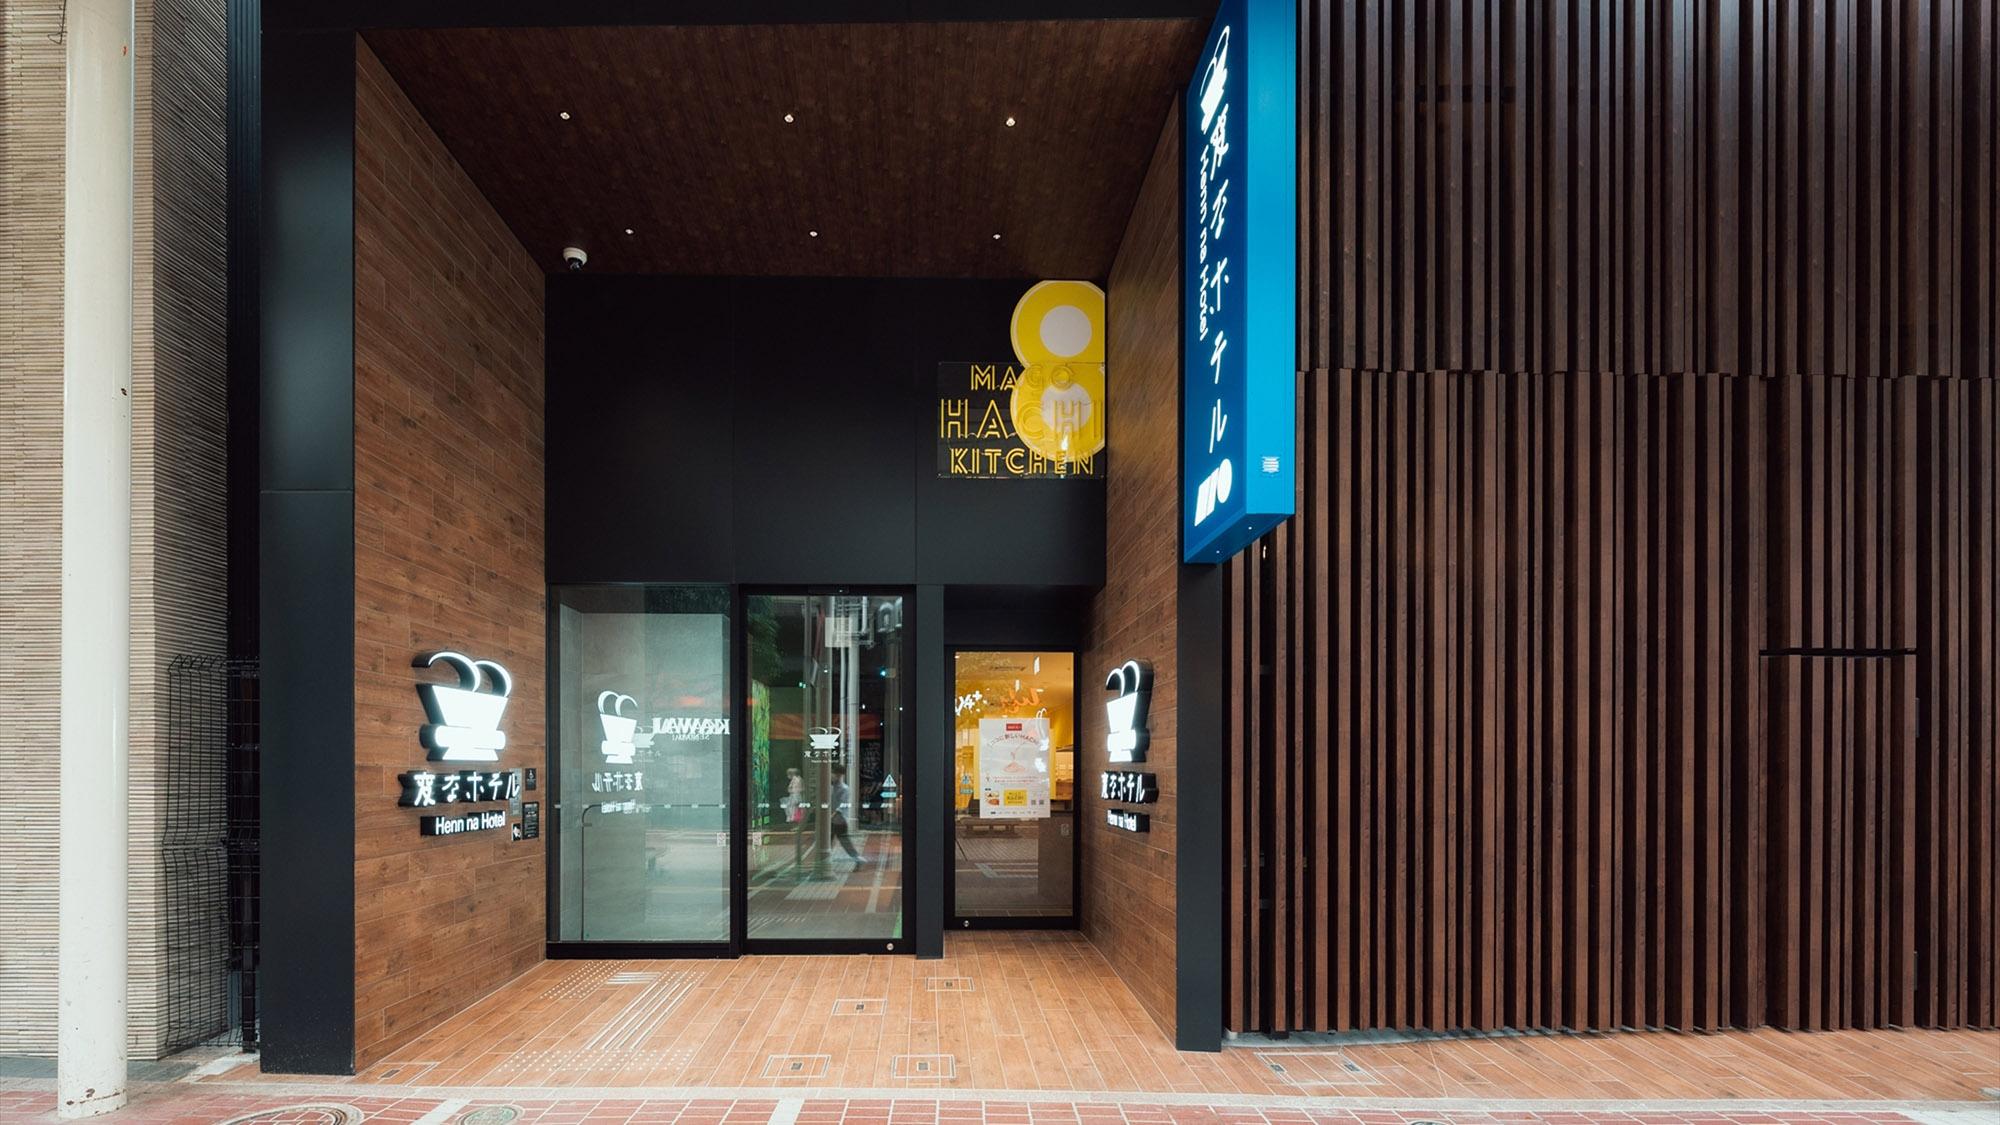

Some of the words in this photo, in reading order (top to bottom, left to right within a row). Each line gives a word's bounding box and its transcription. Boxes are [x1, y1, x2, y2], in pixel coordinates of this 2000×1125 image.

[1200, 144, 1209, 223] Henn
[1200, 226, 1208, 264] na
[1210, 103, 1229, 454] 変なホテル
[1200, 264, 1209, 341] Hotel
[940, 398, 1104, 439] HACHI
[950, 448, 1093, 475] KITCHEN
[413, 771, 521, 807] 変なホテル
[1101, 772, 1145, 803] 変なホテル
[435, 816, 465, 835] Henn
[466, 819, 480, 832] na
[481, 811, 506, 829] Hotel
